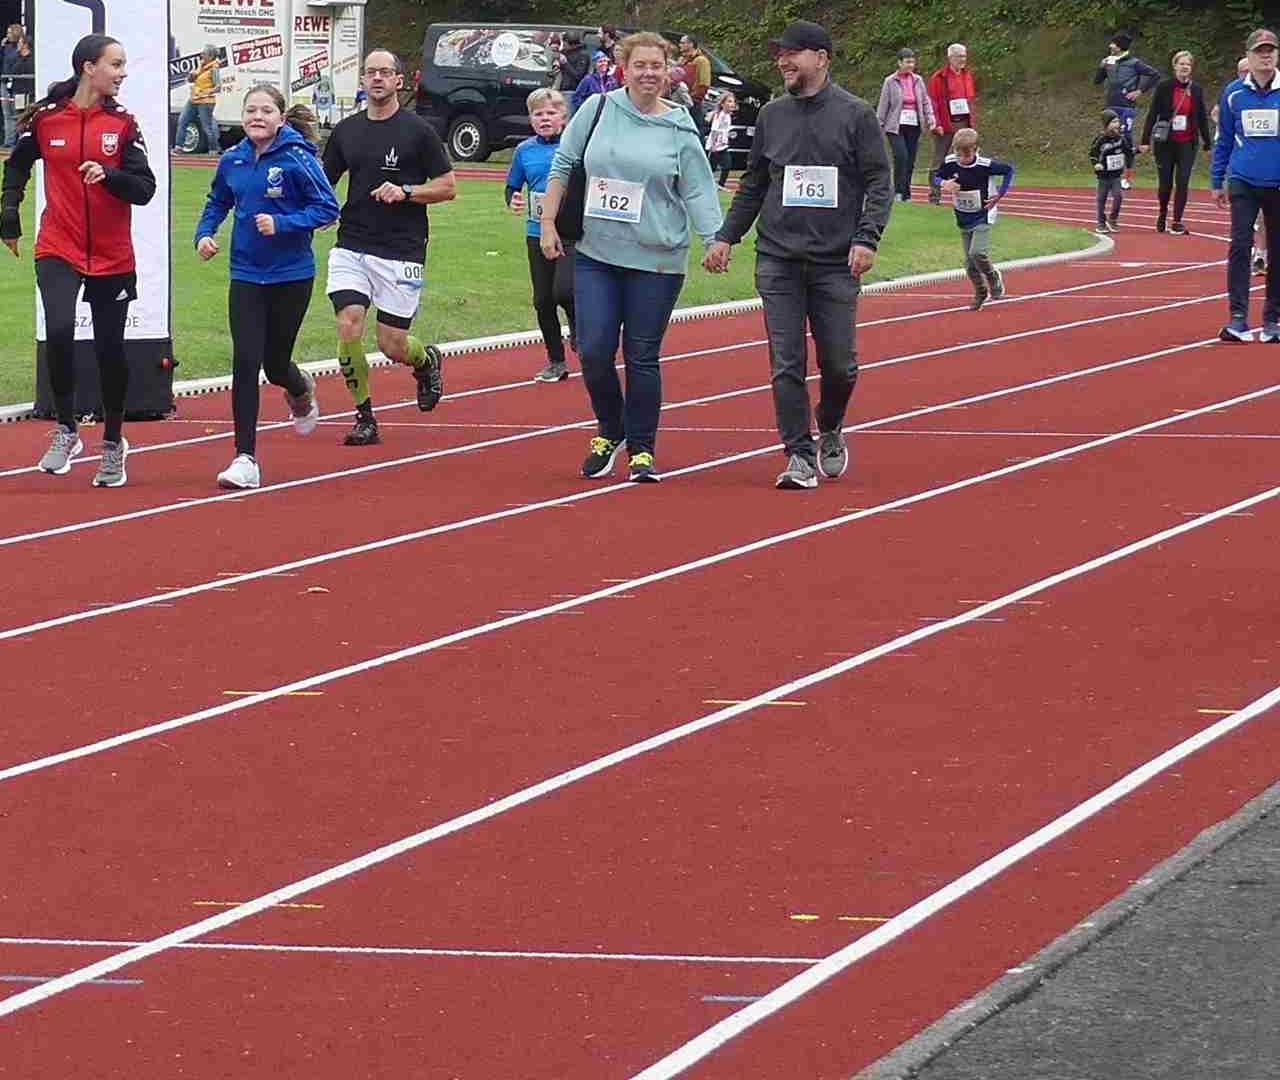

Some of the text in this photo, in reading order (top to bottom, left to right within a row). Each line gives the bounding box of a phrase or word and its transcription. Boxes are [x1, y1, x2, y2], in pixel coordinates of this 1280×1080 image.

[294, 16, 330, 32] REWE
[248, 48, 262, 61] 22
[263, 45, 282, 57] Uhr
[797, 183, 825, 198] 163
[600, 193, 629, 211] 162
